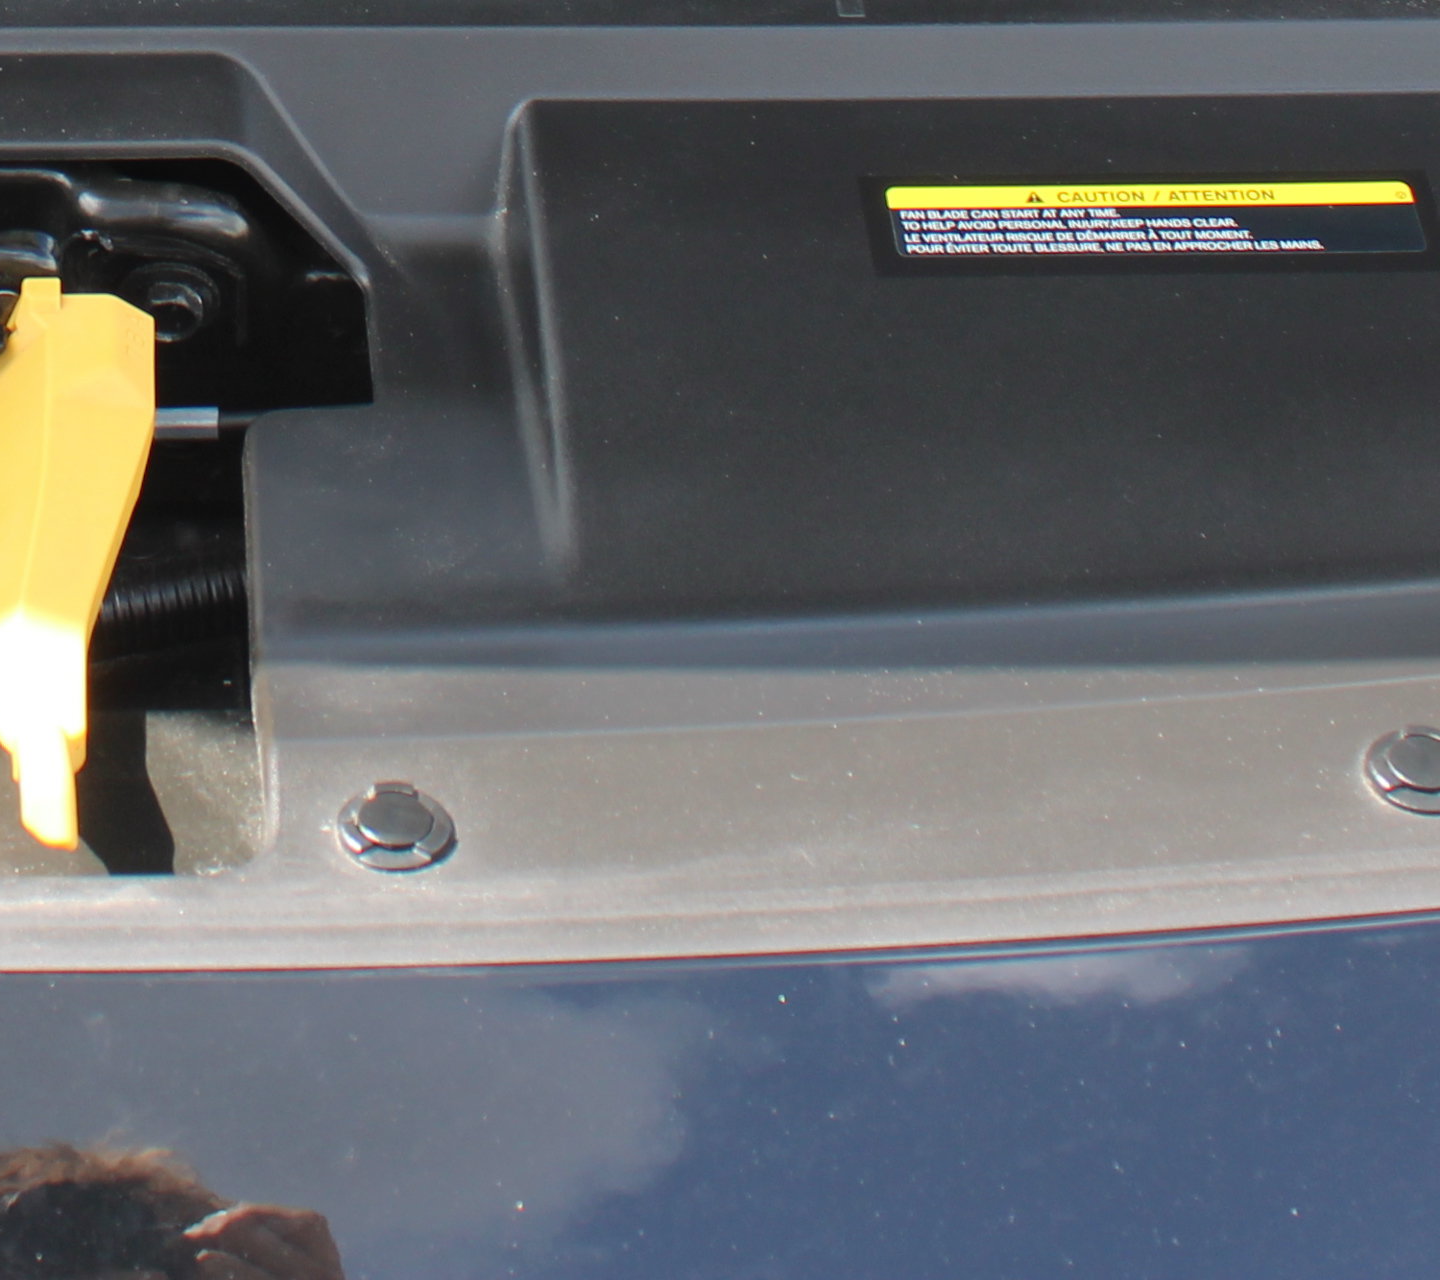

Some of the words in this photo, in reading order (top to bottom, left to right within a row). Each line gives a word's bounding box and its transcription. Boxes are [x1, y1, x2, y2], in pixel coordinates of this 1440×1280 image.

[1057, 191, 1145, 203] CAUTION
[1153, 191, 1160, 201] /
[1168, 190, 1275, 201] ATTENTION
[900, 210, 925, 220] FAN
[927, 210, 969, 219] BLADE
[970, 209, 999, 219] CAN
[1001, 209, 1041, 219] START
[1042, 209, 1057, 218] AT
[1060, 208, 1085, 218] ANY
[1086, 208, 1120, 218] TIME.
[902, 221, 921, 231] TO
[922, 221, 956, 230] HELP
[957, 221, 996, 230] AVOID
[998, 220, 1067, 230] PERSONAL
[1146, 218, 1191, 228] HANDS
[1192, 218, 1238, 227] CLEAR.
[904, 233, 920, 242] LE
[922, 232, 1005, 242] VENTILATEUR
[1006, 232, 1054, 242] RISQUE
[1055, 232, 1074, 241] DE
[1075, 229, 1146, 241] DÉMARRER
[1148, 228, 1160, 240] À
[1161, 230, 1193, 240] TOUT
[1194, 229, 1253, 239] MOMENT.
[906, 244, 944, 254] POUR
[946, 242, 990, 254] ÉVITER
[991, 243, 1032, 253] TOUTE
[1034, 243, 1105, 253] BLESSURE,
[1107, 243, 1124, 252] NE
[1125, 242, 1152, 252] PAS
[1153, 241, 1173, 251] EN
[1174, 241, 1254, 251] APPROCHER
[1255, 240, 1279, 250] LES
[1281, 240, 1325, 250] MAINS.
